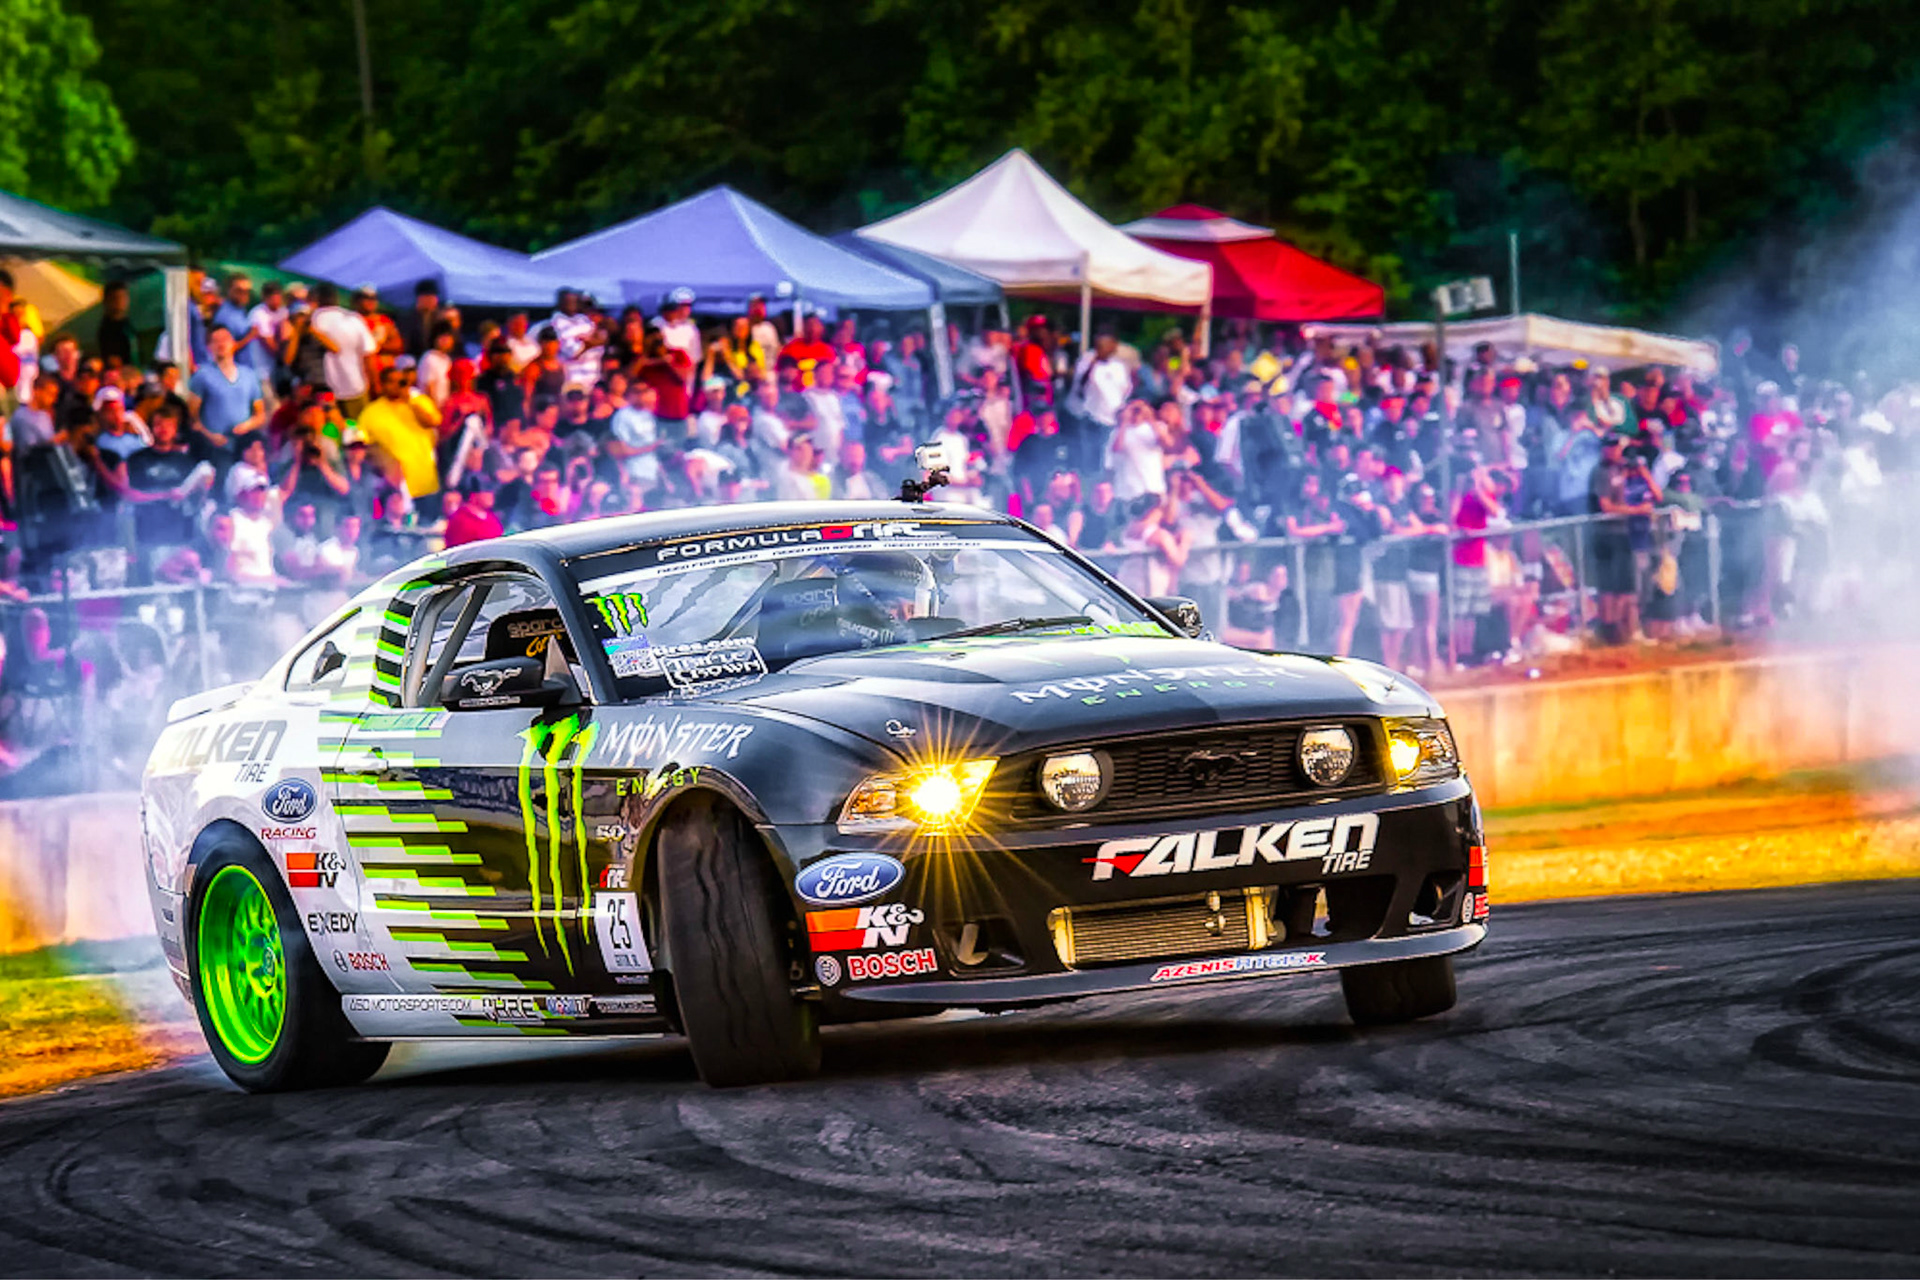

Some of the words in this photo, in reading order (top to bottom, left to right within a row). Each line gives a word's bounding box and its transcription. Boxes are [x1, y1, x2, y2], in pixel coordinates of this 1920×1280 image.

[507, 617, 564, 638] sparc
[168, 720, 288, 767] ALKEN
[272, 786, 309, 816] Ford
[261, 827, 317, 840] RACING
[1091, 812, 1381, 882] FALKEN
[1321, 850, 1375, 875] TIRE
[815, 861, 881, 898] Ford
[307, 912, 358, 936] EXEDY
[607, 898, 632, 949] 25
[348, 952, 391, 971] BOSCH
[847, 948, 938, 981] BOSCH
